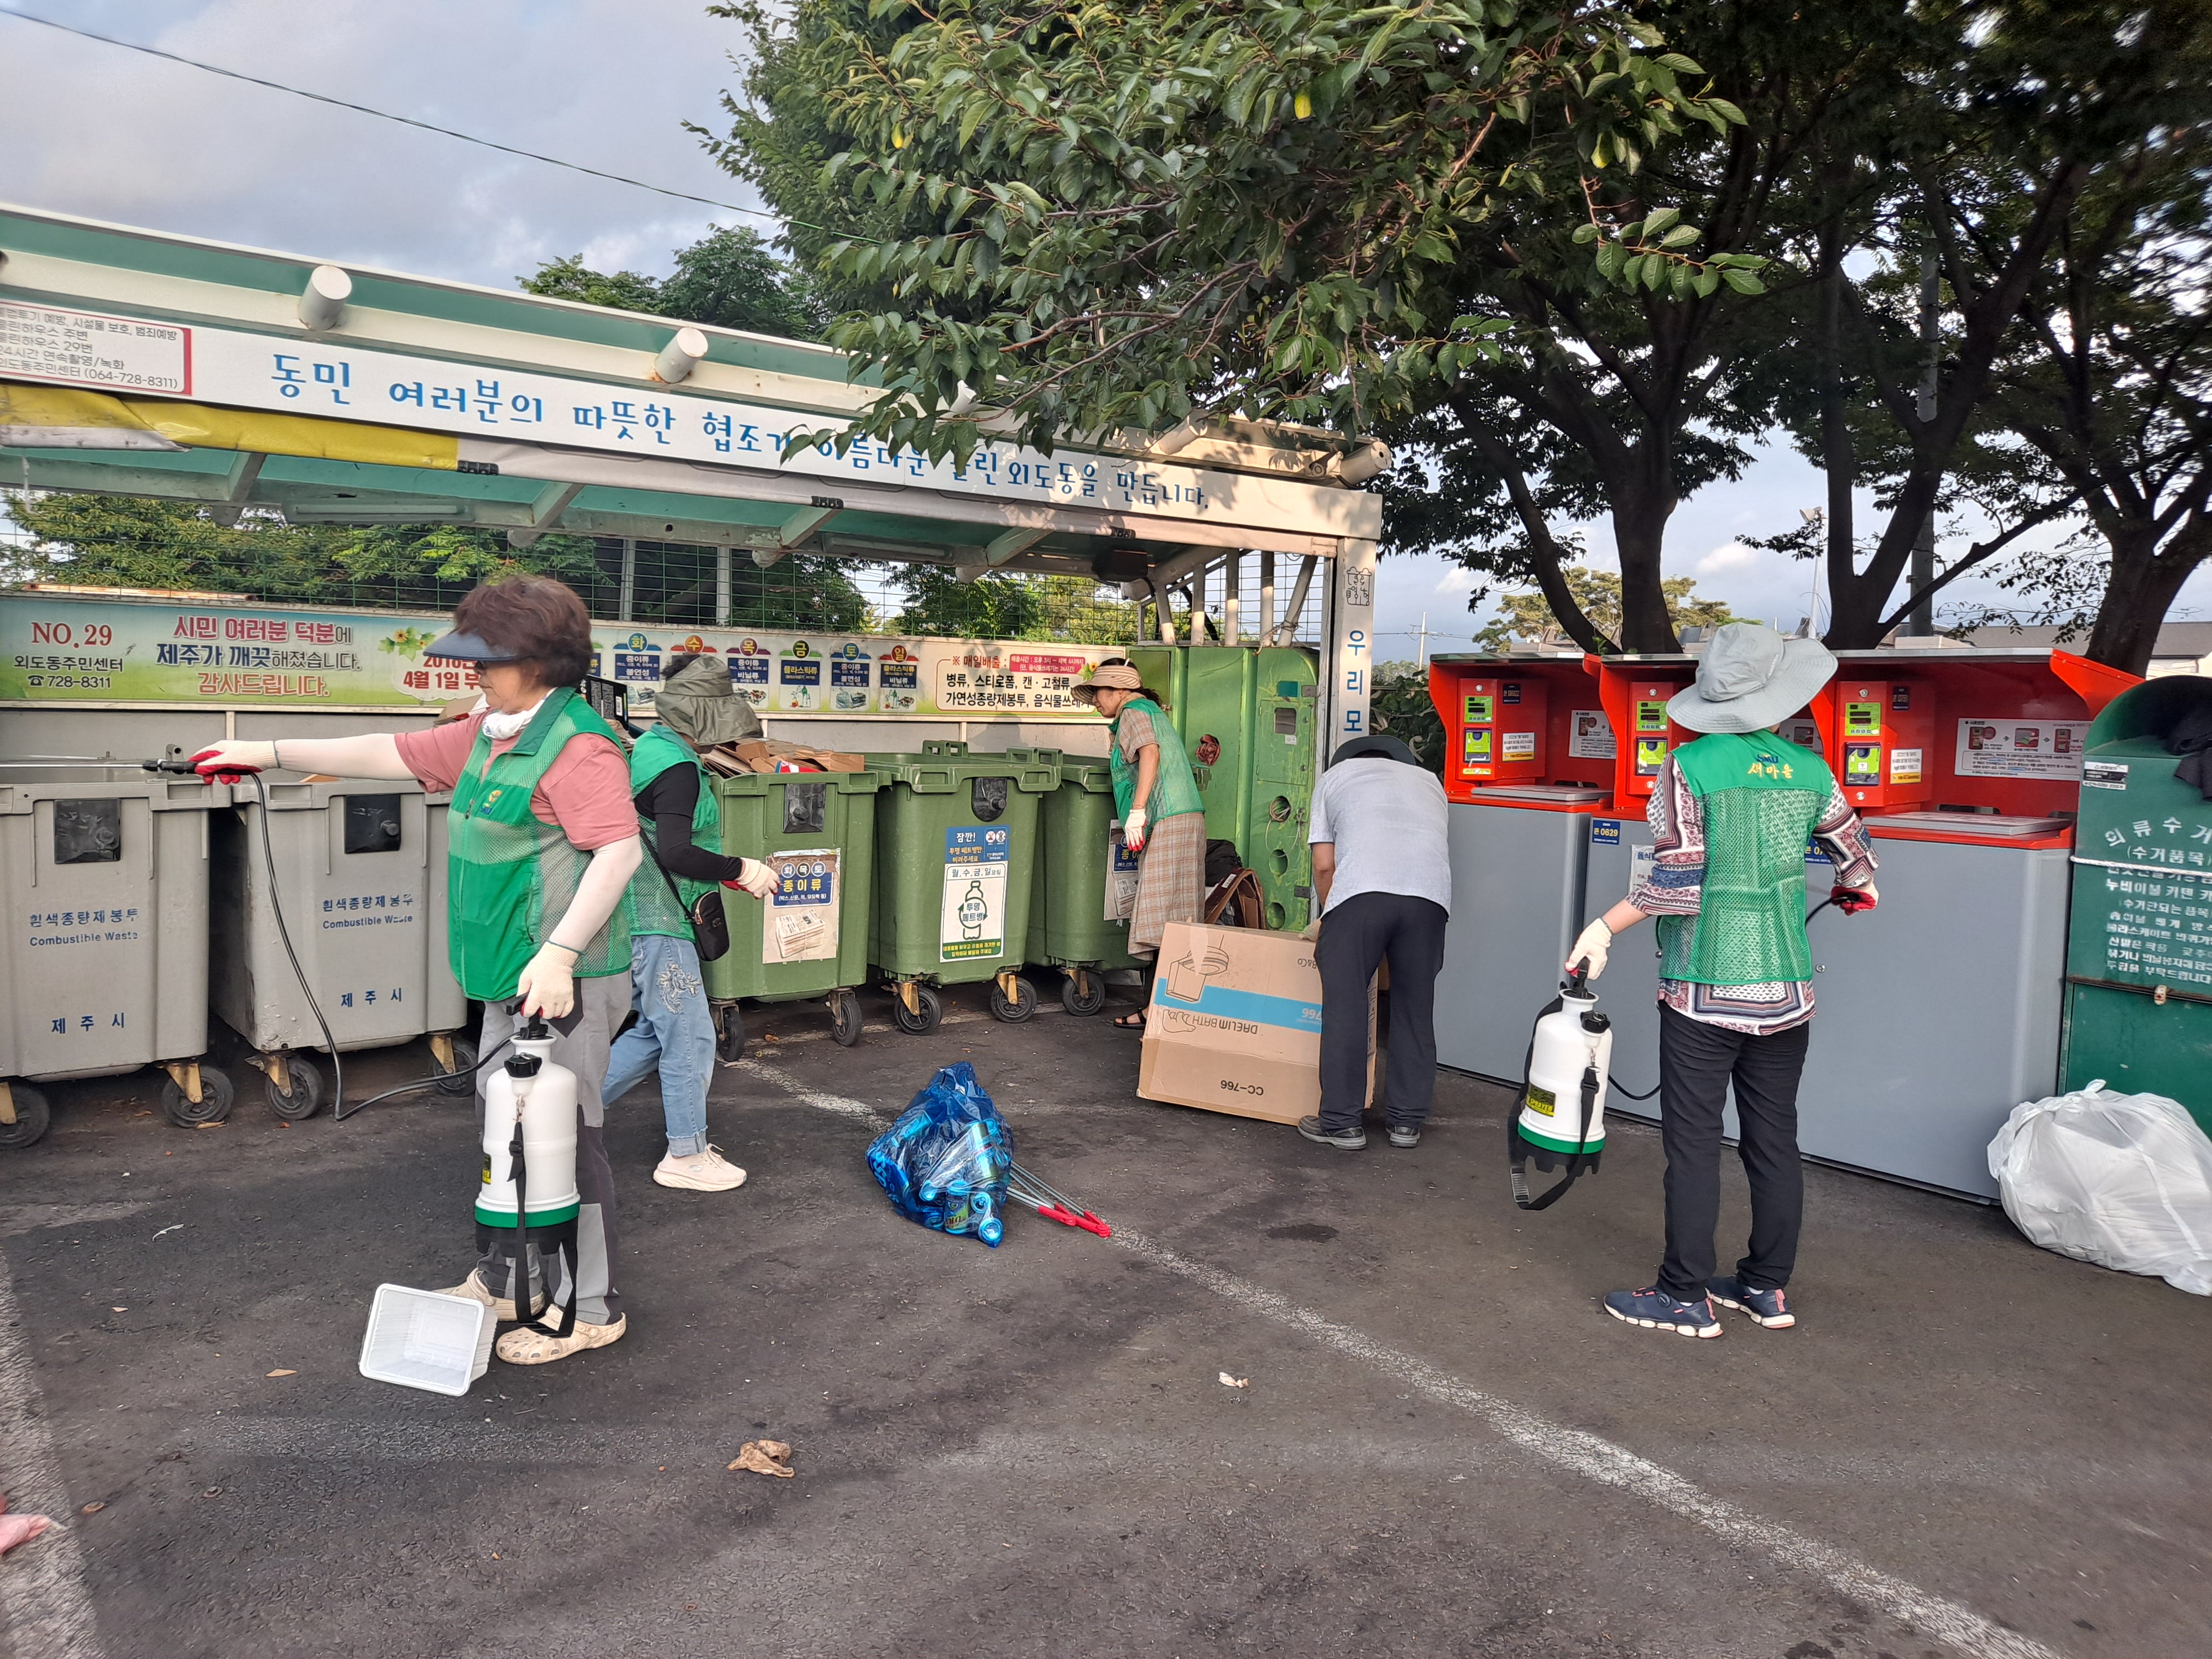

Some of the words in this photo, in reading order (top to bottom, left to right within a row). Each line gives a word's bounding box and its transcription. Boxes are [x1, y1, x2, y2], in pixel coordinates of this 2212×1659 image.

[64, 328, 88, 341] 주변
[135, 326, 177, 341] 범죄예방
[64, 341, 93, 354] 29번
[84, 368, 178, 389] (064-728-8311)
[271, 353, 351, 405] 동민
[389, 379, 542, 424] 여러분의
[572, 400, 676, 445] 따뜻한
[1008, 461, 1098, 498] 외도동을
[1117, 471, 1209, 509] 만듭니다.
[173, 615, 217, 639] 시민
[225, 617, 288, 642] 여러분
[294, 620, 352, 644] 덕분에
[687, 636, 701, 650] 수
[795, 643, 807, 656] 금
[156, 643, 223, 667] 제주가
[229, 645, 362, 671] 깨끗해졌습니다.
[845, 645, 857, 657] 토
[894, 647, 905, 661] 일
[14, 655, 124, 672] 외도동주민센터
[963, 655, 1001, 669] 매일배출
[47, 675, 111, 688] 728-8311
[197, 671, 331, 697] 감사드립니다.
[403, 670, 429, 690] 4월
[435, 671, 459, 690] 1일
[947, 673, 969, 688] 병류,
[974, 675, 1017, 690] 스티로폼,
[946, 692, 1029, 708] 가연성종량제봉투,
[956, 832, 976, 843] 잠깐!
[1600, 828, 1618, 837] 0629
[784, 865, 792, 875] 화
[800, 865, 807, 874] 목
[813, 865, 822, 873] 토
[783, 879, 821, 893] 종이류
[966, 902, 980, 911] 투명
[323, 916, 382, 929] Combustible
[29, 933, 101, 946] Combustible
[1192, 1015, 1217, 1028] BATH
[1219, 1019, 1258, 1034] DAELIM
[1220, 1079, 1264, 1095] CC-766
